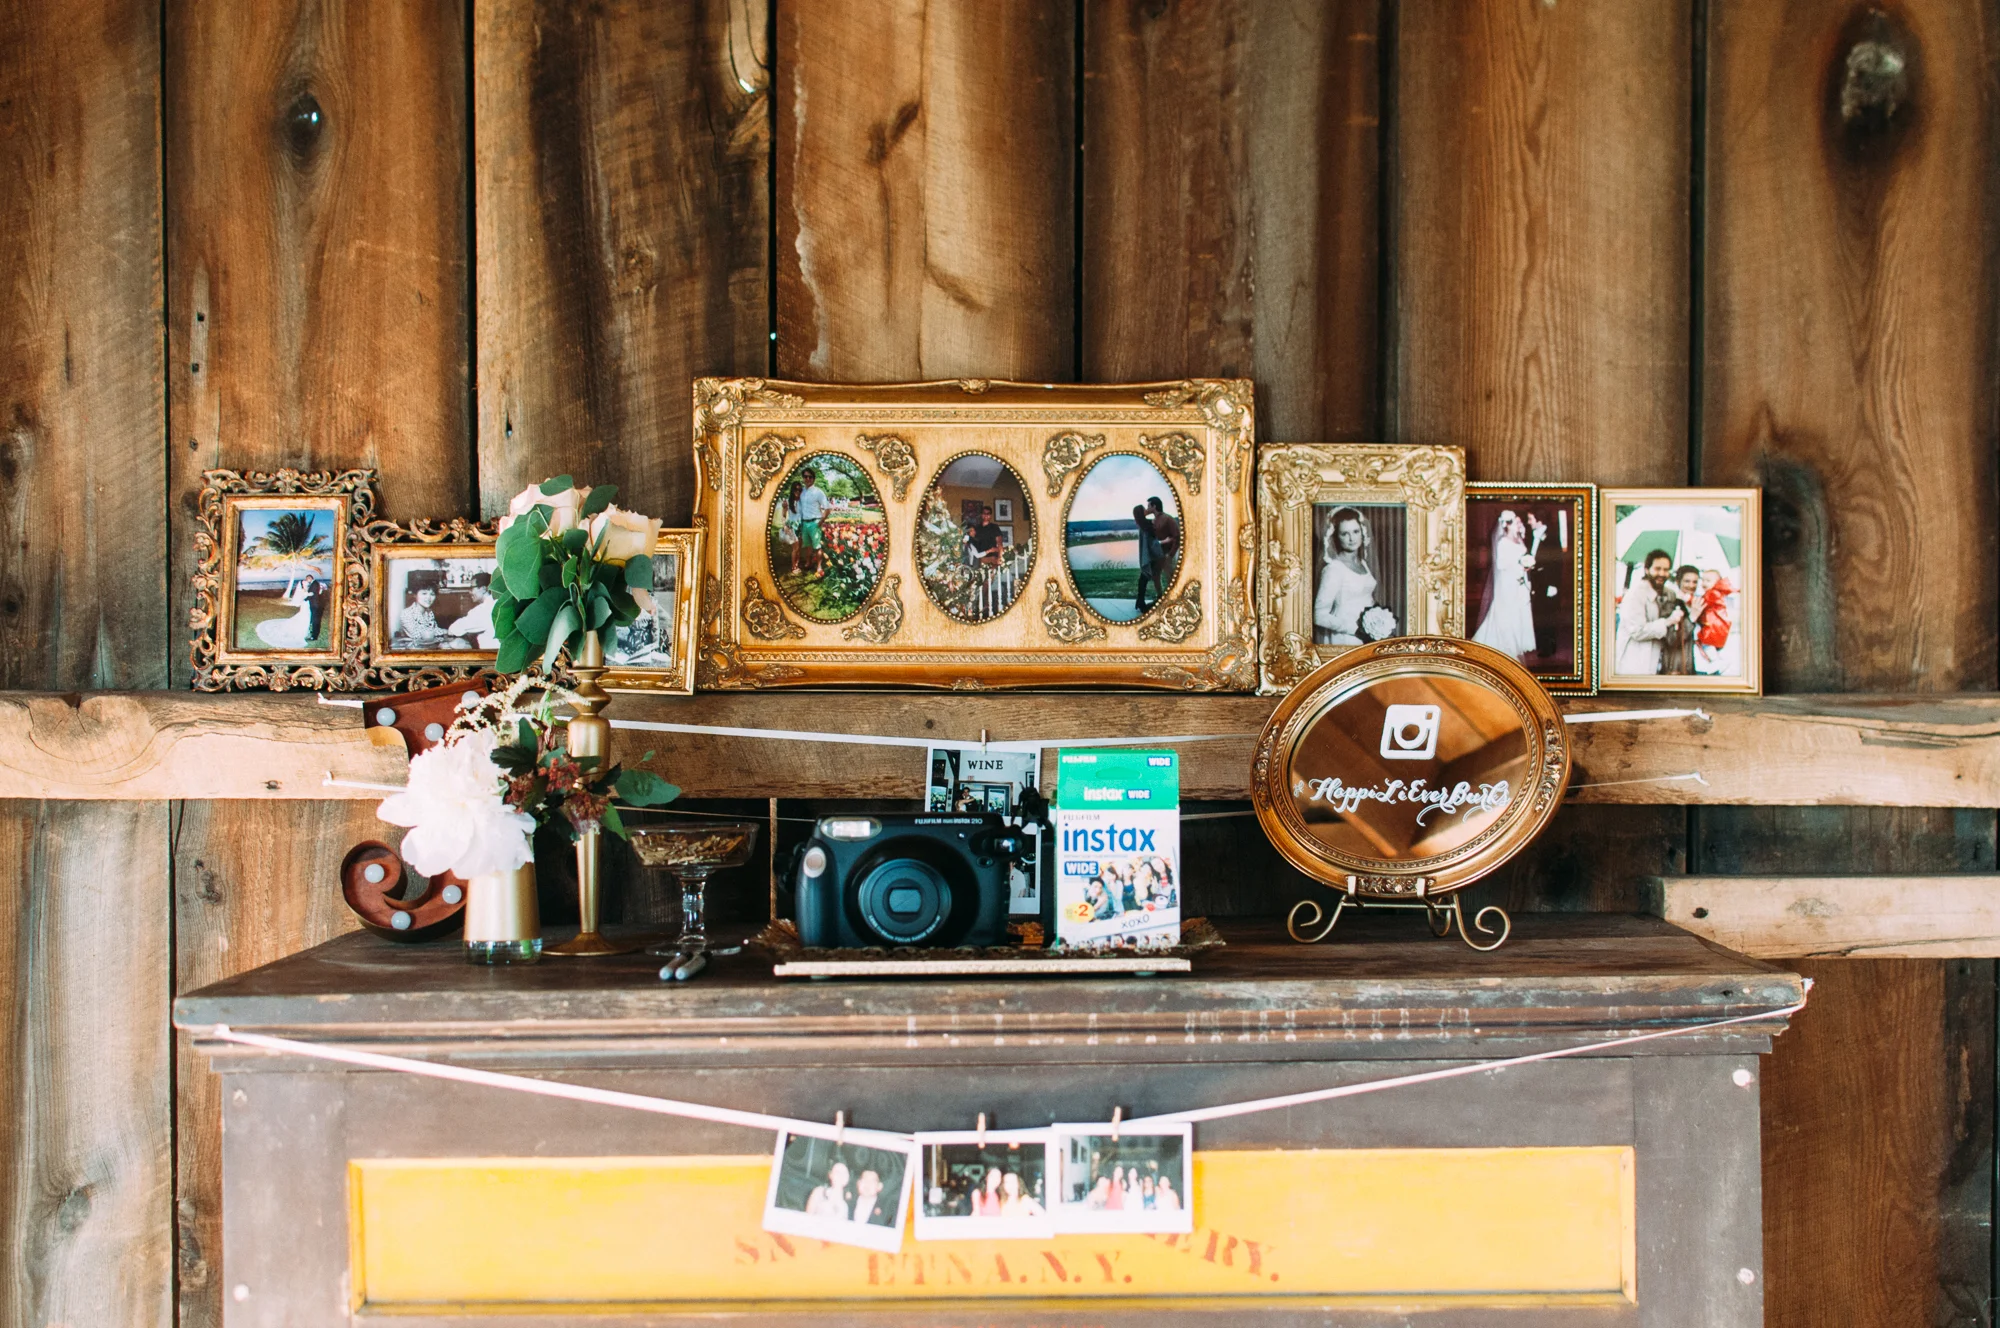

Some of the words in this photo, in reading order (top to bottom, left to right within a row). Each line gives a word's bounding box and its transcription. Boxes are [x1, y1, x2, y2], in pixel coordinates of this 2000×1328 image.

[968, 760, 1003, 770] WINE
[1149, 758, 1171, 766] WIDE
[1084, 787, 1125, 801] instax
[1128, 790, 1150, 799] WIDE
[1063, 823, 1155, 853] instax
[1066, 863, 1097, 875] WIDE
